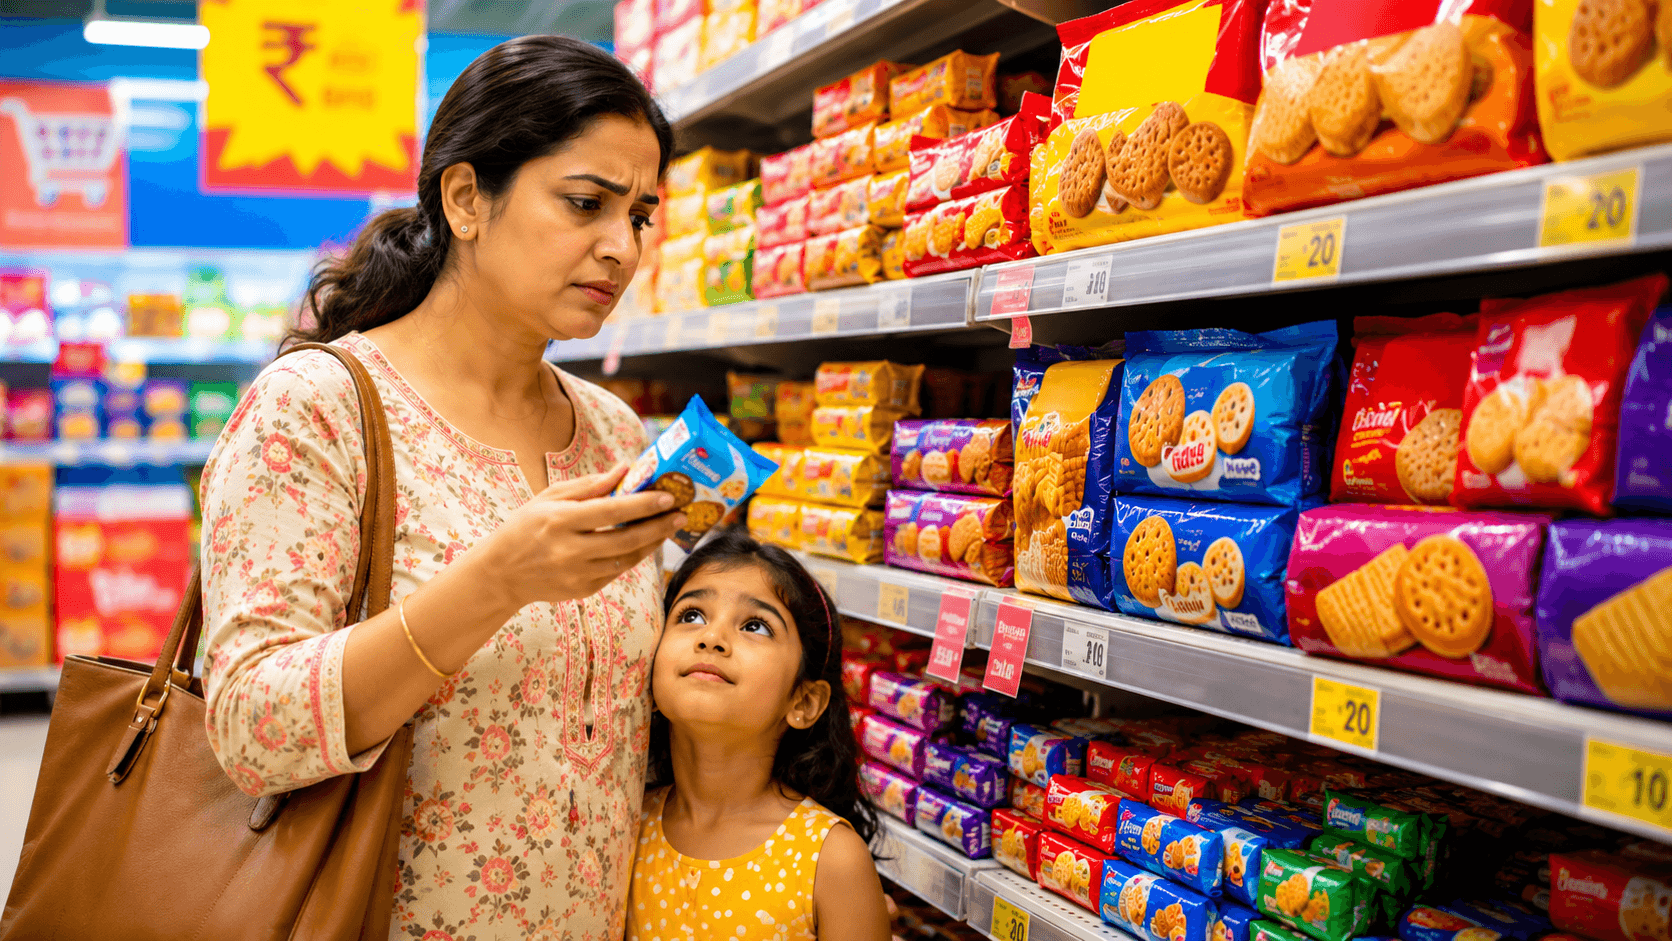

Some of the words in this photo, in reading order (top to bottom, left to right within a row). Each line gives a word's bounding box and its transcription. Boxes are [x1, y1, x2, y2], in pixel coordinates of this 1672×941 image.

[261, 21, 318, 107] ₹
[1587, 185, 1628, 231] 20
[1307, 233, 1335, 268] 20
[1344, 699, 1371, 736] 20
[1631, 767, 1668, 813] 10
